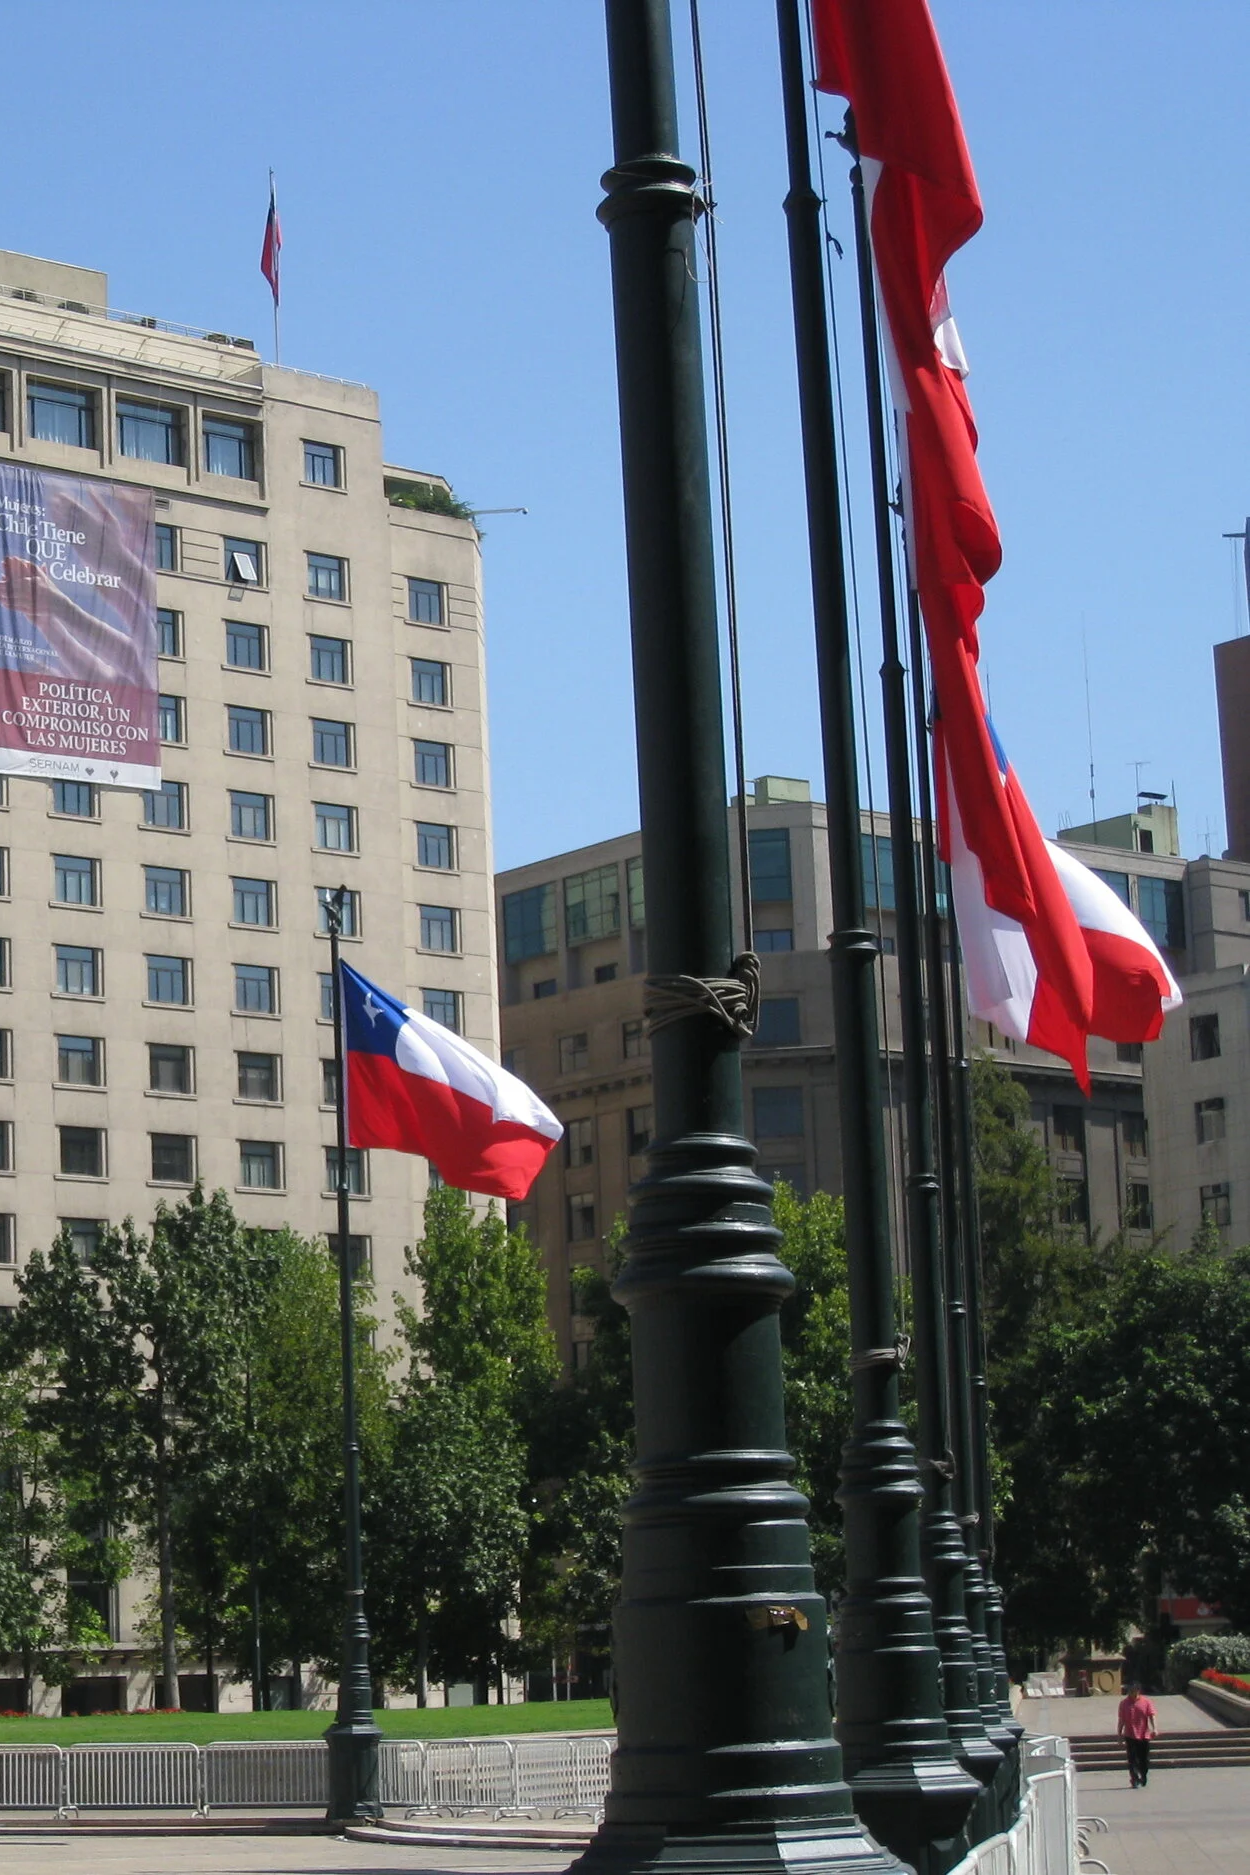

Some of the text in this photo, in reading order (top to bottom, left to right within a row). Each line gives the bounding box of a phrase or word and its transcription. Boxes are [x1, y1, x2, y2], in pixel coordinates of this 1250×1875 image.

[39, 521, 86, 545] Tiene
[26, 538, 67, 561] QUE
[50, 561, 121, 589] Celebrar
[38, 682, 113, 705] POLÍTICA
[21, 696, 130, 722] EXTERIOR, UN
[2, 710, 149, 741] COMPROMISO CON
[26, 730, 127, 755] LAS MUJERES
[29, 757, 80, 772] SERNAM
